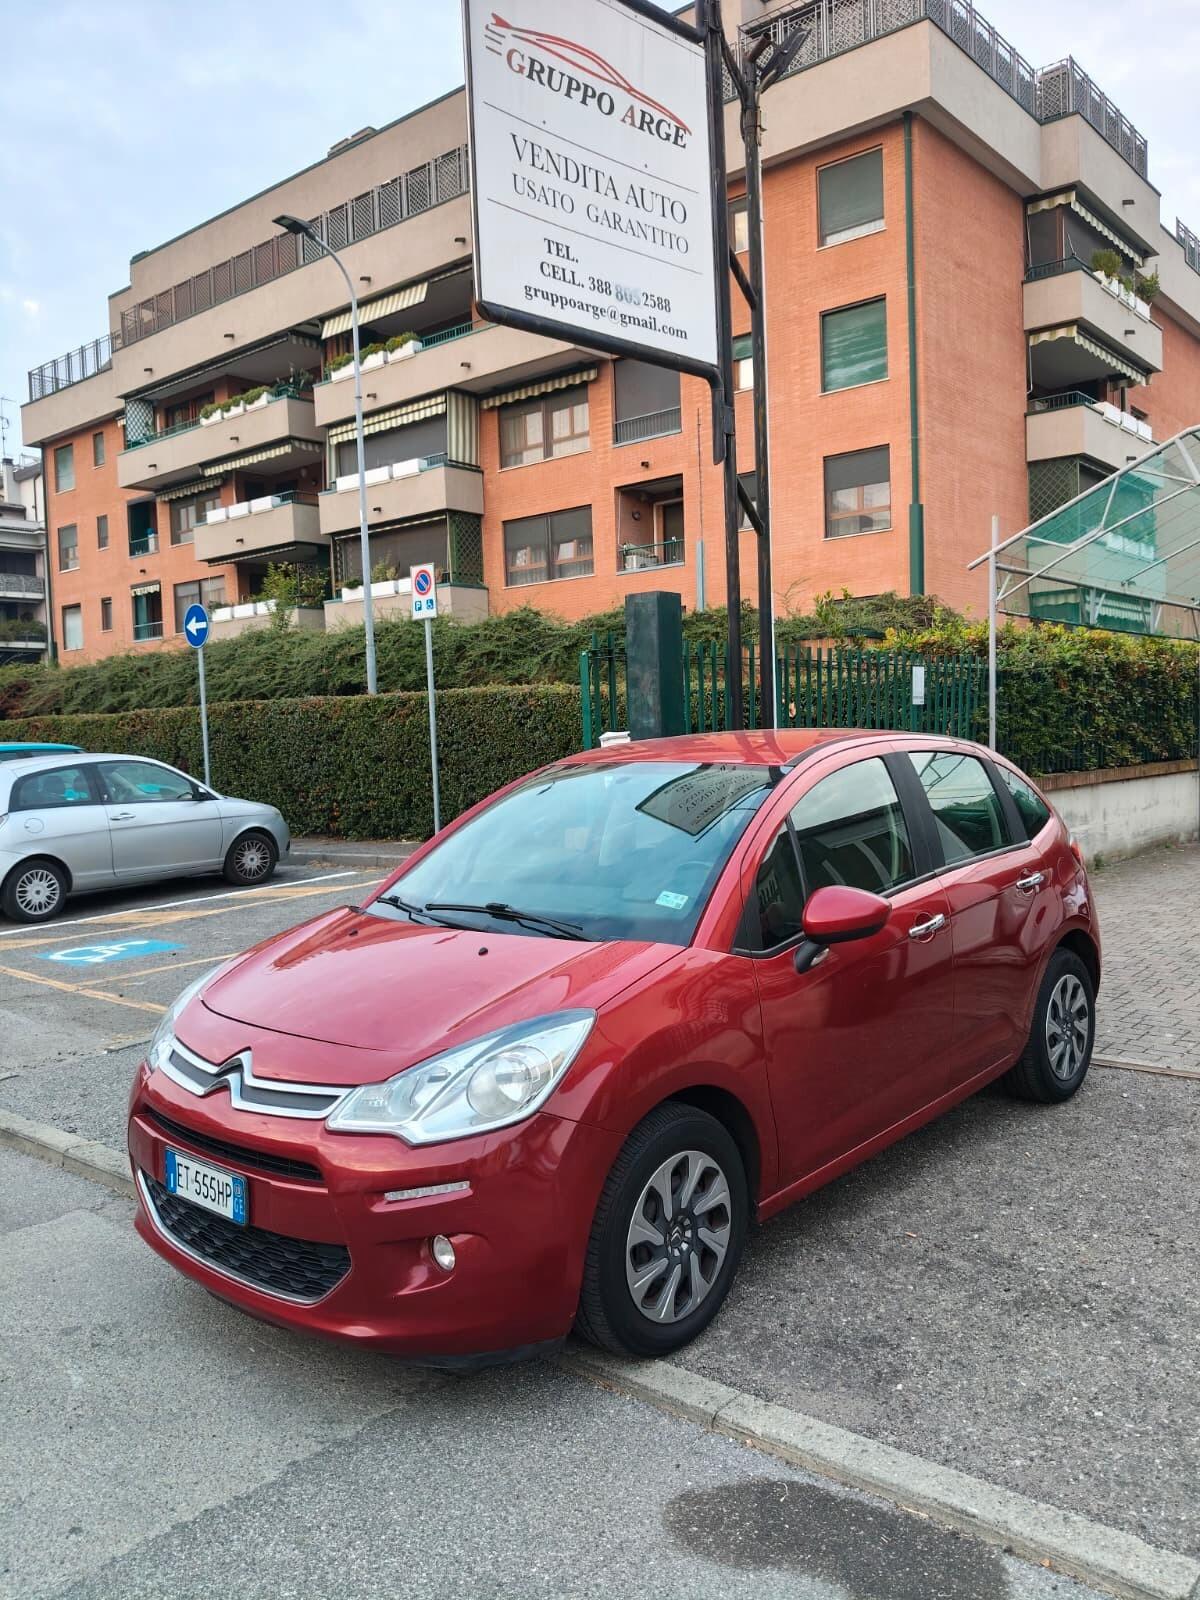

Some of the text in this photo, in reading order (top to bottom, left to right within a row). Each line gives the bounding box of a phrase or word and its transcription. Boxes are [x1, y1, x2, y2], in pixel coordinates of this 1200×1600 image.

[506, 48, 687, 149] GRUPPO ARGE
[510, 132, 687, 225] VENDITA AUTO
[512, 172, 689, 254] USATO GARANTITO
[543, 237, 580, 264] TEL.
[524, 284, 688, 340] gruppoarge@gmail.com
[539, 261, 585, 289] CELL.
[588, 276, 612, 296] 388
[641, 291, 671, 313] 2588
[177, 1162, 190, 1192] ET
[195, 1170, 232, 1208] 555HP
